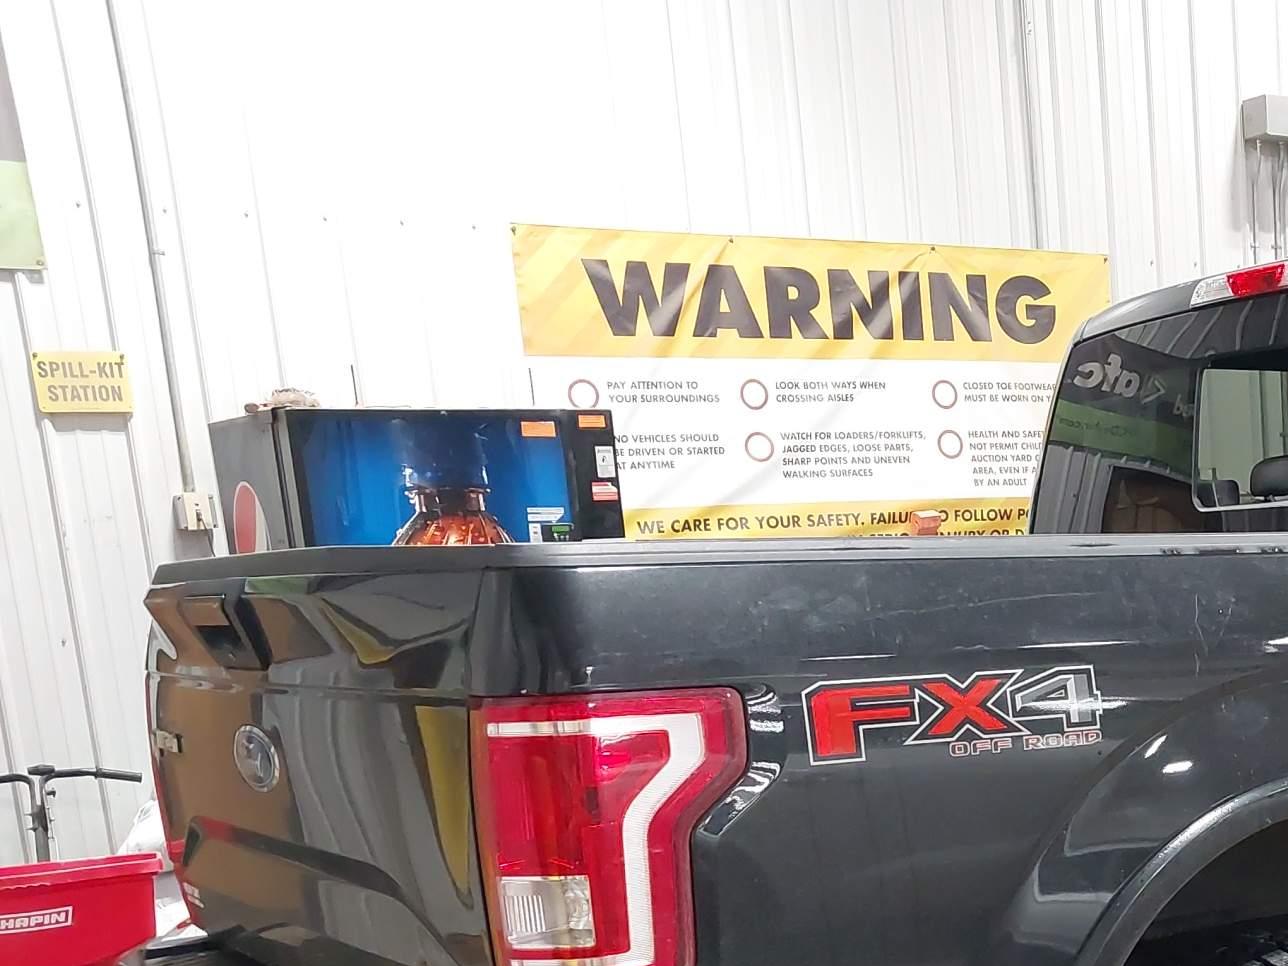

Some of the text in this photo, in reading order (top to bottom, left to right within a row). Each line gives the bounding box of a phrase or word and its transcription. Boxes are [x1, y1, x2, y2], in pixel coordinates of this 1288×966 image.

[581, 257, 1057, 345] WARNING
[37, 360, 125, 378] SPILL-KIT
[607, 381, 699, 390] PAY ATTENTION TO
[775, 381, 886, 390] LOOK BOTH WAYS WHEN
[962, 382, 993, 390] CLOSED
[996, 382, 1012, 390] TOE
[47, 385, 124, 402] STATION
[776, 394, 854, 403] CROSSING AISLES
[964, 394, 987, 402] MUST
[989, 394, 999, 402] BE
[1001, 394, 1029, 402] WORN
[1031, 394, 1044, 402] ON
[608, 394, 720, 404] YOUR SURROUNDINGS
[614, 433, 719, 443] NO VEHICLES SHOULD
[780, 431, 927, 440] WATCH FOR LOADERS/FORKLIFTS,
[968, 430, 999, 439] HEALTH
[1001, 430, 1021, 438] AND
[615, 446, 725, 456] BE DRIVEN OR STARTED
[782, 443, 914, 454] JAGGED EDGES, LOOSE PARTS,
[969, 442, 987, 450] NOT
[989, 442, 1018, 450] PERMIT
[630, 460, 675, 470] ANYTIME
[782, 456, 910, 466] SHARP POINTS AND UNEVEN
[782, 469, 873, 479] WALKING SURFACES
[972, 467, 996, 475] AREA,
[973, 478, 1027, 487] BY AN ADULT
[637, 520, 665, 534] WE
[670, 518, 712, 533] CARE
[717, 516, 750, 531] FOR
[755, 515, 802, 529] YOUR
[806, 512, 865, 528] SAFETY.
[954, 508, 1013, 521] FOLLOW
[801, 665, 1104, 766] FX4
[949, 730, 1102, 757] OFF ROAD
[0, 911, 66, 930] HAPIN
